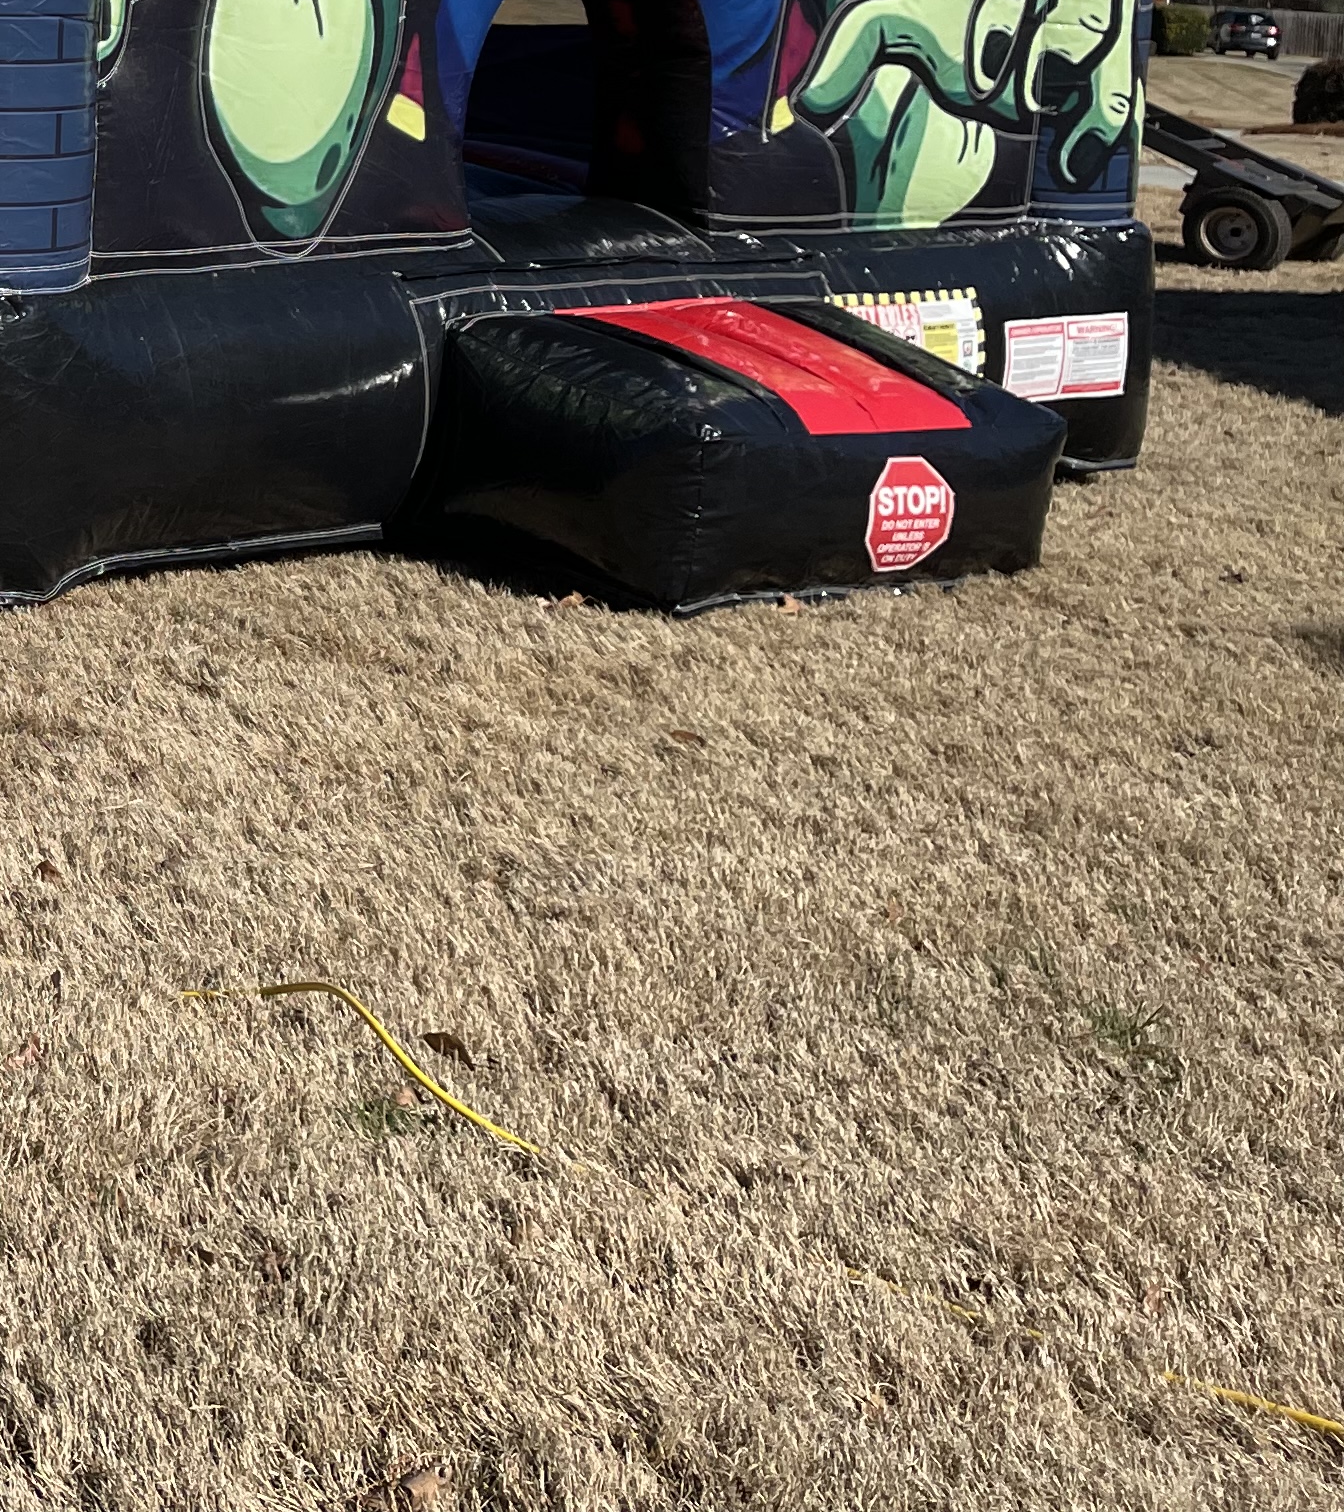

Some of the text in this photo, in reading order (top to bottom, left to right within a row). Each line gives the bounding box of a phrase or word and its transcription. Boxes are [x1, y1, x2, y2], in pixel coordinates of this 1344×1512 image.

[877, 485, 947, 516] STOP!
[881, 518, 941, 531] DO NOT ENTER
